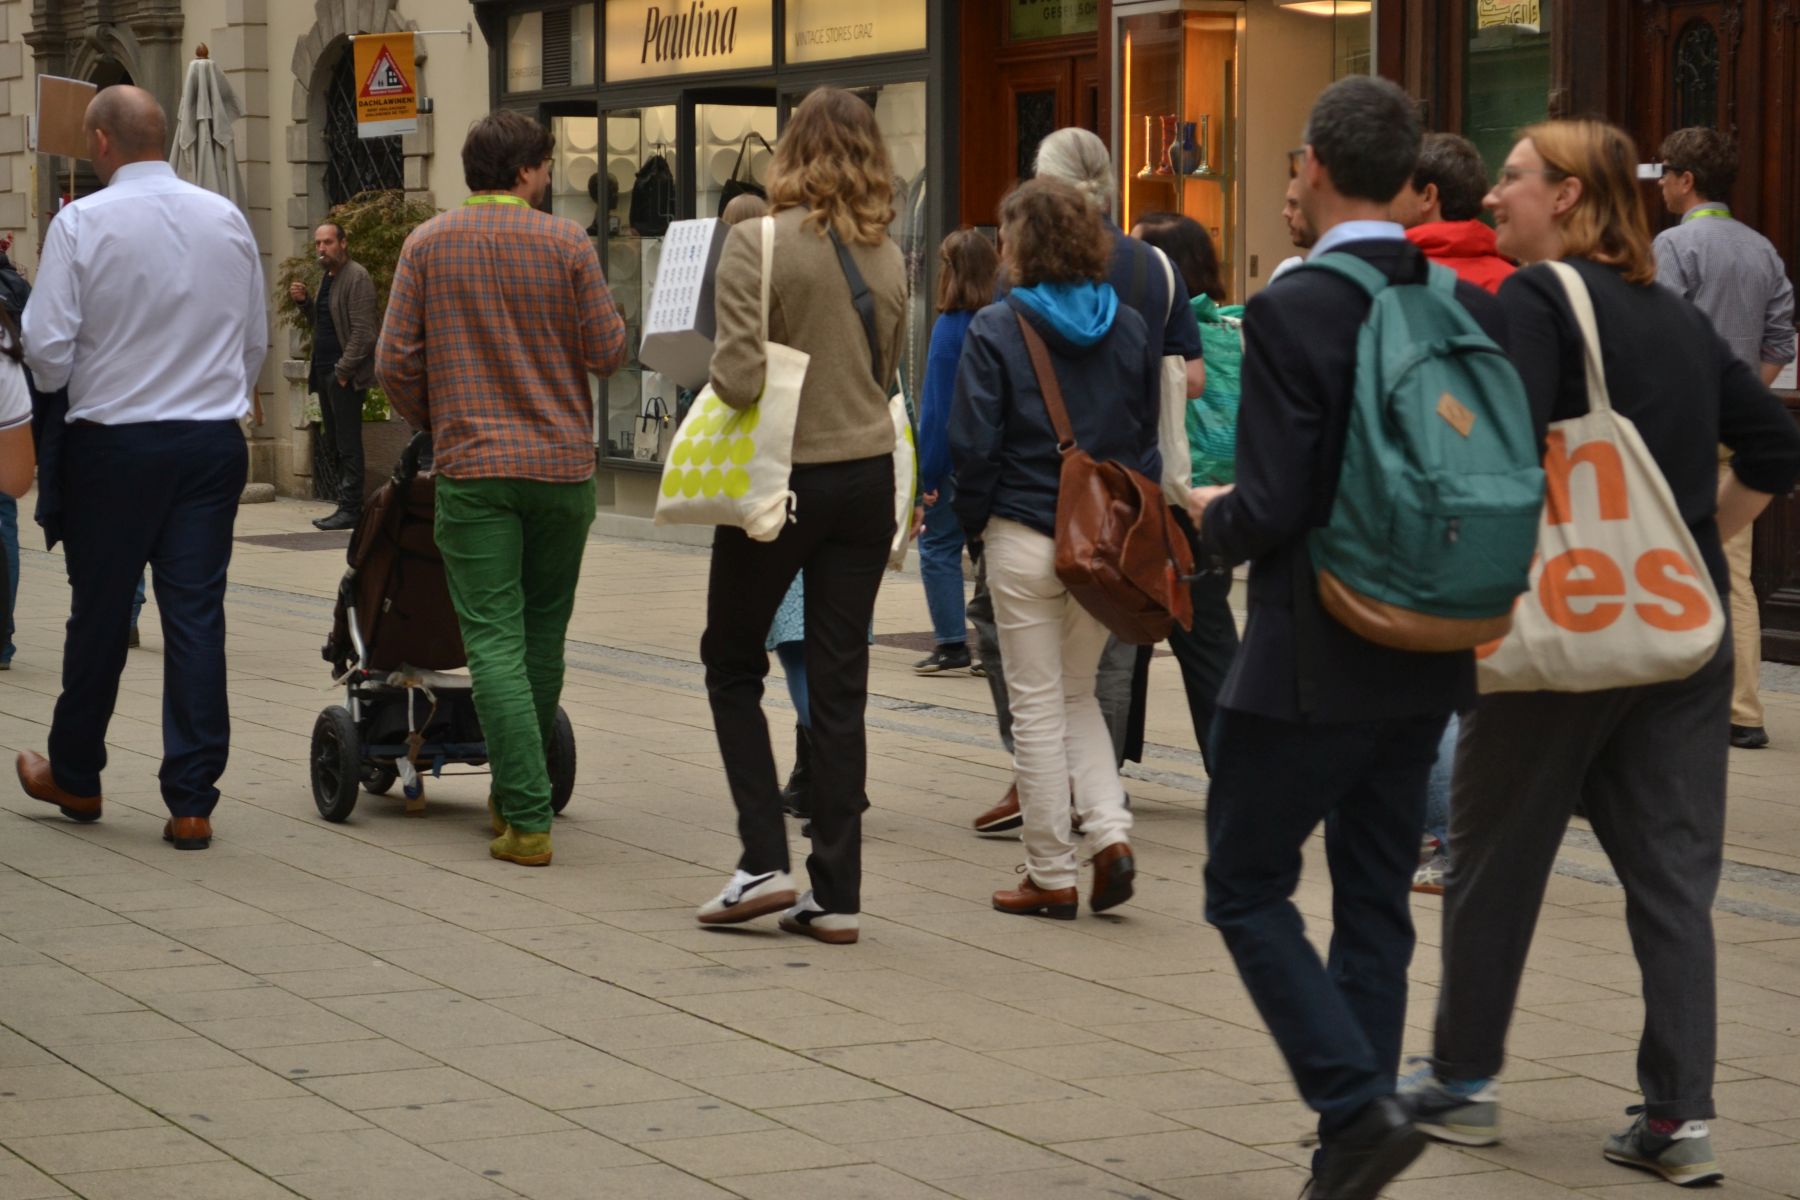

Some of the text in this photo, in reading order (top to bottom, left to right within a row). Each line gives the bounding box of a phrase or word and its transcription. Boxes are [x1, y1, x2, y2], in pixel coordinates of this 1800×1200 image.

[641, 0, 738, 64] Paulina
[794, 22, 873, 47] VINTAGE STORES GRAZ
[358, 97, 415, 107] DACHLAWINEN!
[1534, 547, 1712, 633] es
